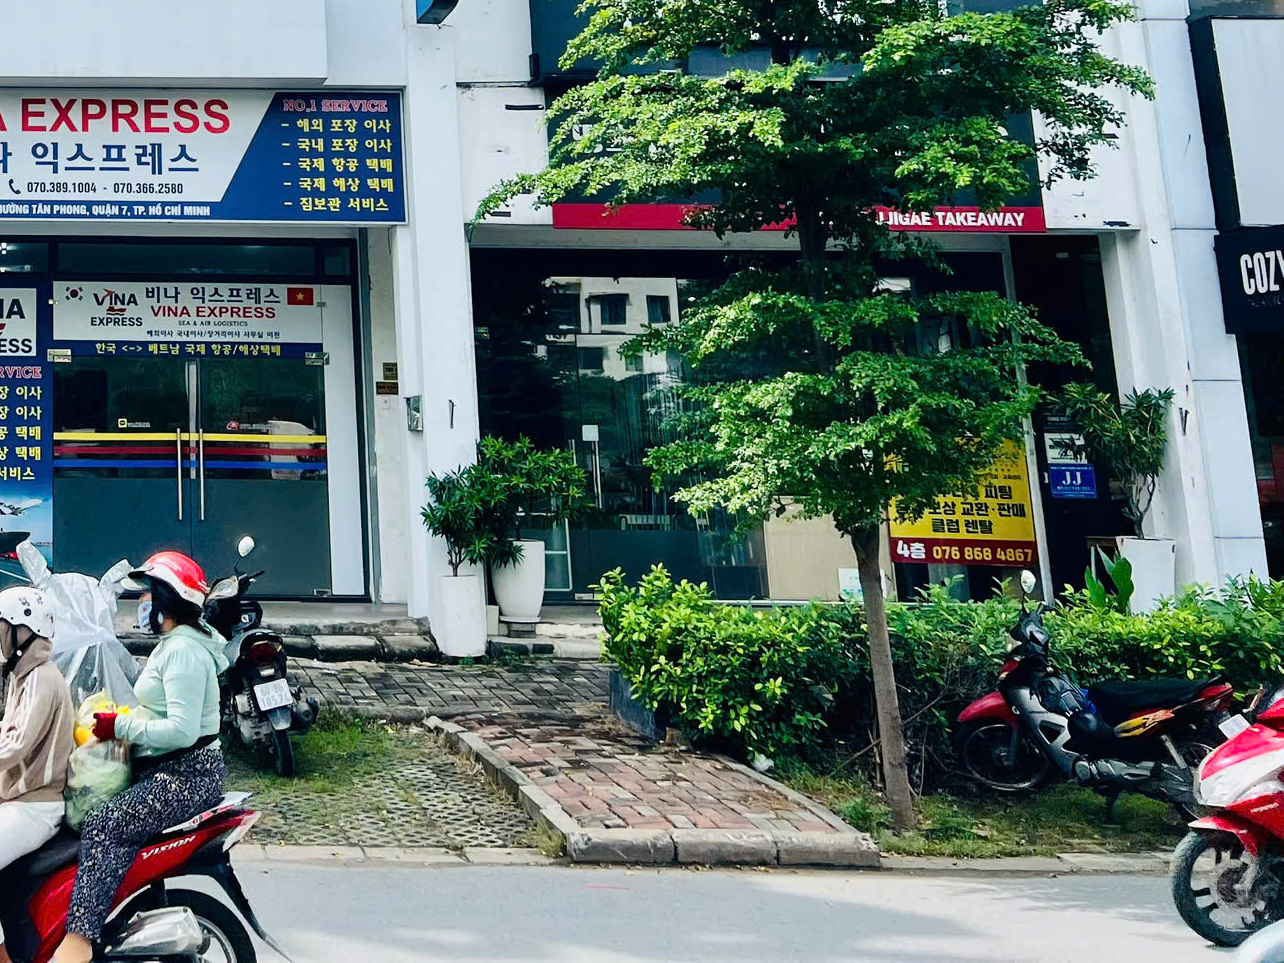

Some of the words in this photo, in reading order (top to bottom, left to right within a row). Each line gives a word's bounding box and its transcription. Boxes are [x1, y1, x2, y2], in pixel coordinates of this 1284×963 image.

[282, 99, 317, 113] NO.1
[321, 99, 389, 113] SERVICE
[21, 97, 231, 135] EXPRESS
[296, 118, 324, 133] 해외
[330, 118, 358, 133] 포장
[364, 119, 391, 134] 이사
[297, 138, 325, 153] 국내
[331, 138, 359, 153] 포장
[364, 138, 393, 153] 이사
[30, 141, 200, 176] 익스프레스
[297, 157, 325, 172] 국제
[331, 157, 359, 173] 항공
[365, 158, 394, 173] 택배
[26, 181, 98, 195] 070.389.1004
[112, 182, 184, 195] 070.366.2580
[298, 177, 326, 192] 국제
[332, 177, 361, 193] 해상
[366, 178, 395, 193] 택배
[28, 201, 48, 216] TÂN
[49, 204, 90, 218] PHONG,
[92, 202, 120, 217] QUẬN
[121, 205, 131, 217] 7,
[133, 205, 147, 216] TP.
[183, 205, 211, 217] MINH
[299, 197, 342, 212] 짐보관
[347, 197, 390, 212] 서비스
[934, 211, 1025, 227] TAKEAWAY
[92, 292, 139, 307] VINA
[145, 286, 181, 304] 비나
[190, 287, 281, 305] 익스프레스
[150, 305, 191, 318] VINA
[195, 306, 276, 319] EXPRESS
[90, 316, 143, 327] EXPRESS
[95, 343, 117, 354] 한국
[148, 343, 180, 355] 베트남
[15, 385, 43, 401] 이사
[15, 405, 43, 421] 이사
[15, 425, 42, 441] 택배
[15, 446, 42, 461] 택배
[1062, 471, 1082, 486] JJ
[931, 518, 961, 534] 클럽
[964, 519, 994, 535] 렌탈
[896, 539, 926, 559] 4층
[932, 546, 960, 560] 076
[996, 548, 1032, 562] 4867
